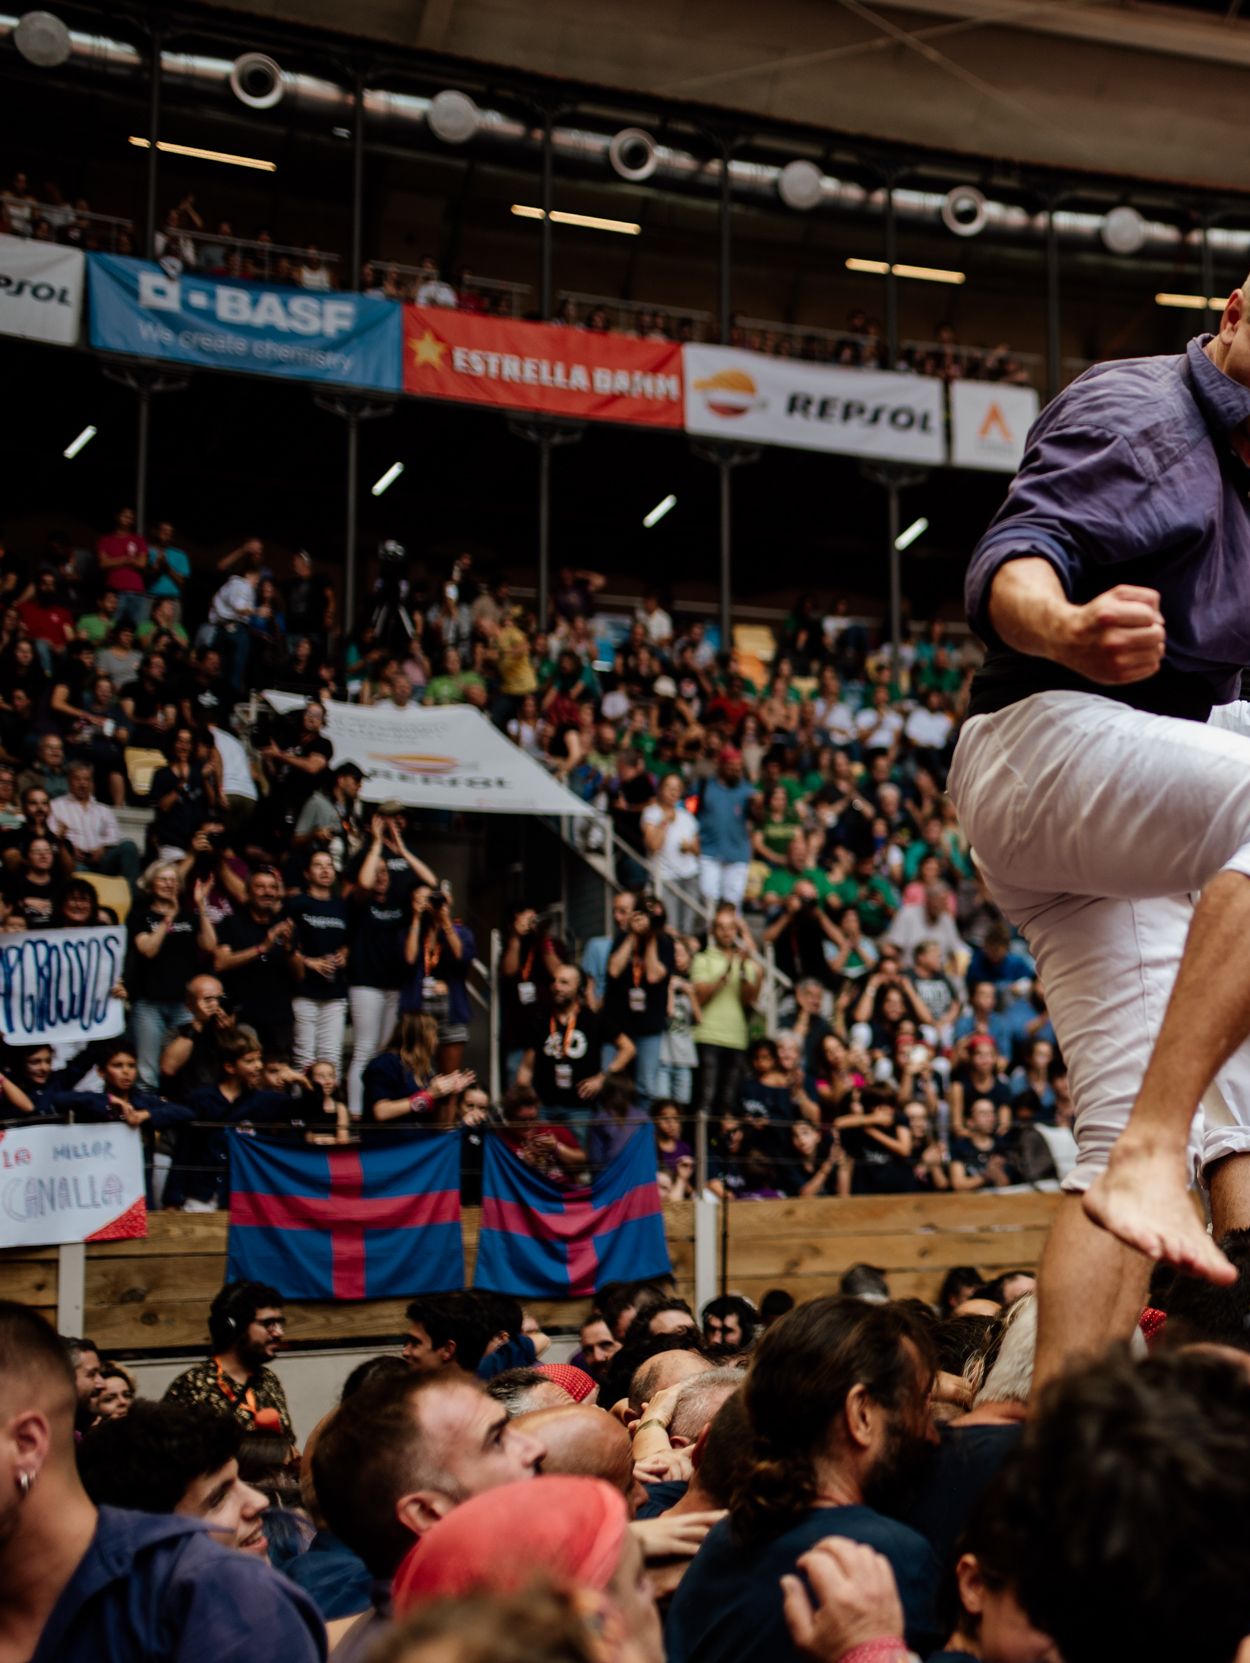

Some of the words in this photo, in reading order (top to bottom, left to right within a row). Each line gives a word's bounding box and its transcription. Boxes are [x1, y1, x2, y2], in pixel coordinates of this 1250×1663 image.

[214, 284, 355, 338] BASF
[138, 319, 175, 344] We
[178, 329, 249, 357] create
[252, 338, 354, 374] chemistry
[452, 346, 590, 392] ESTRELLA
[592, 366, 681, 401] DAMM
[786, 391, 935, 435] REPSOL
[2, 1172, 124, 1223] CANALLA
